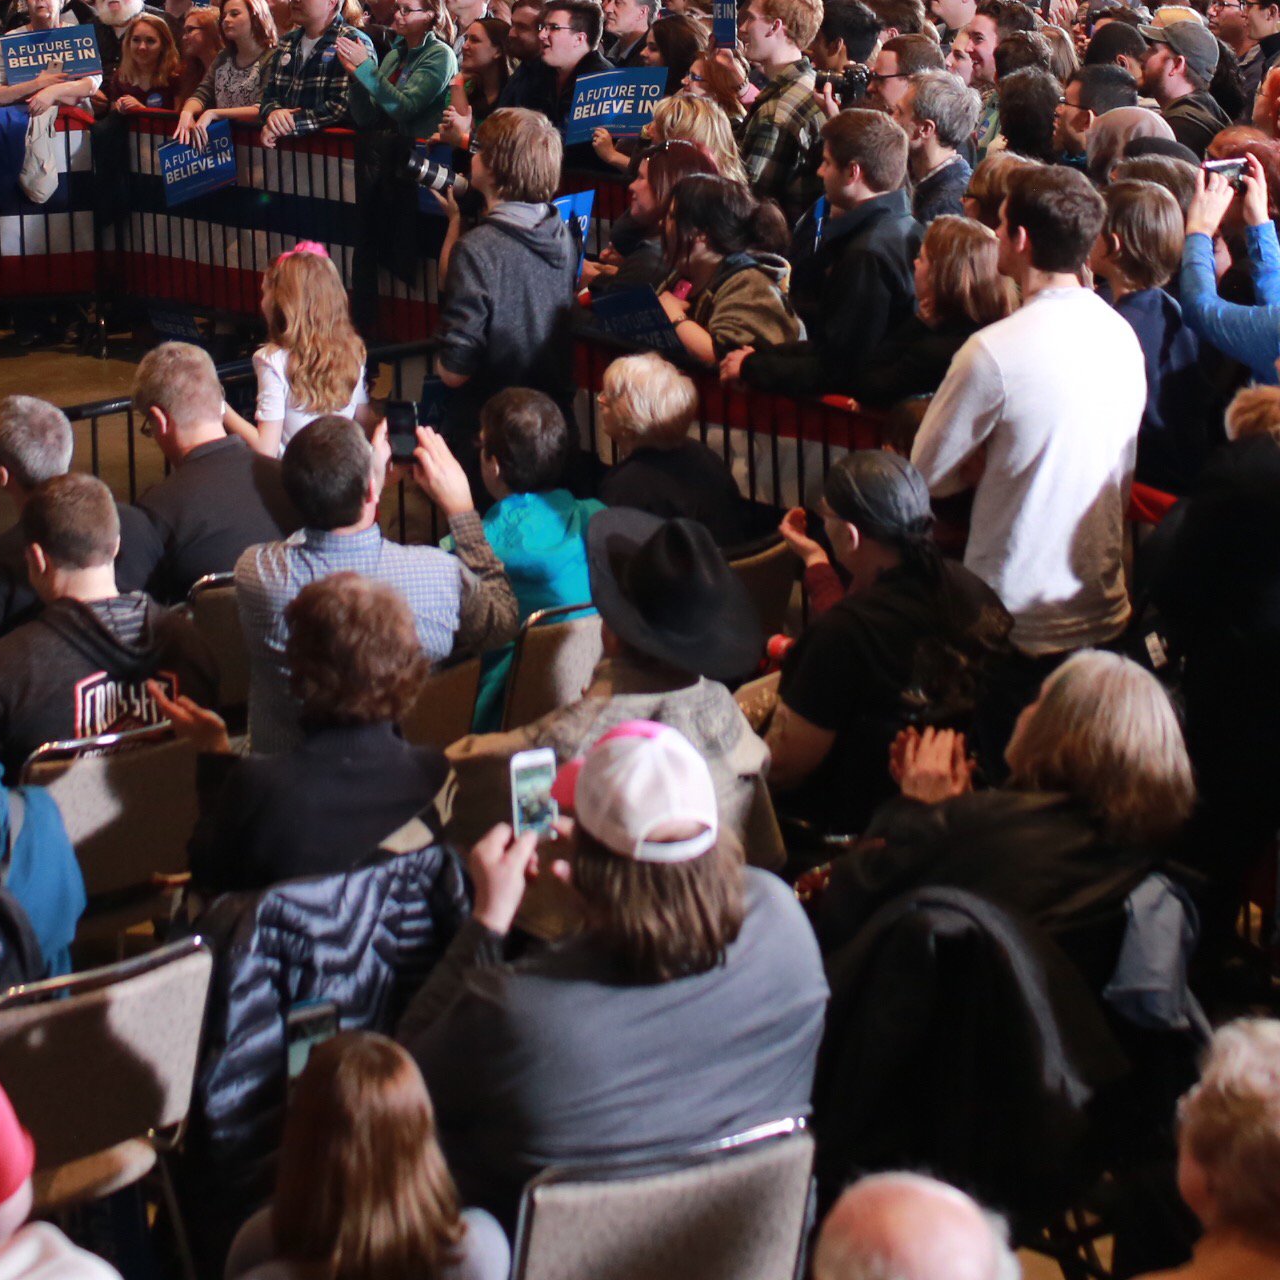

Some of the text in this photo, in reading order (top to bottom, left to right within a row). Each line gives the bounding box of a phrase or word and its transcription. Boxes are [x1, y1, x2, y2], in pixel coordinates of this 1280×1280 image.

[723, 3, 734, 19] IN
[7, 37, 93, 56] A FUTURE TO
[8, 48, 96, 69] BELIEVE IN
[577, 84, 660, 104] A FUTURE TO
[573, 100, 656, 120] BELIEVE IN
[165, 159, 172, 170] A
[213, 136, 229, 149] TO
[166, 149, 232, 185] BELIEVE IN
